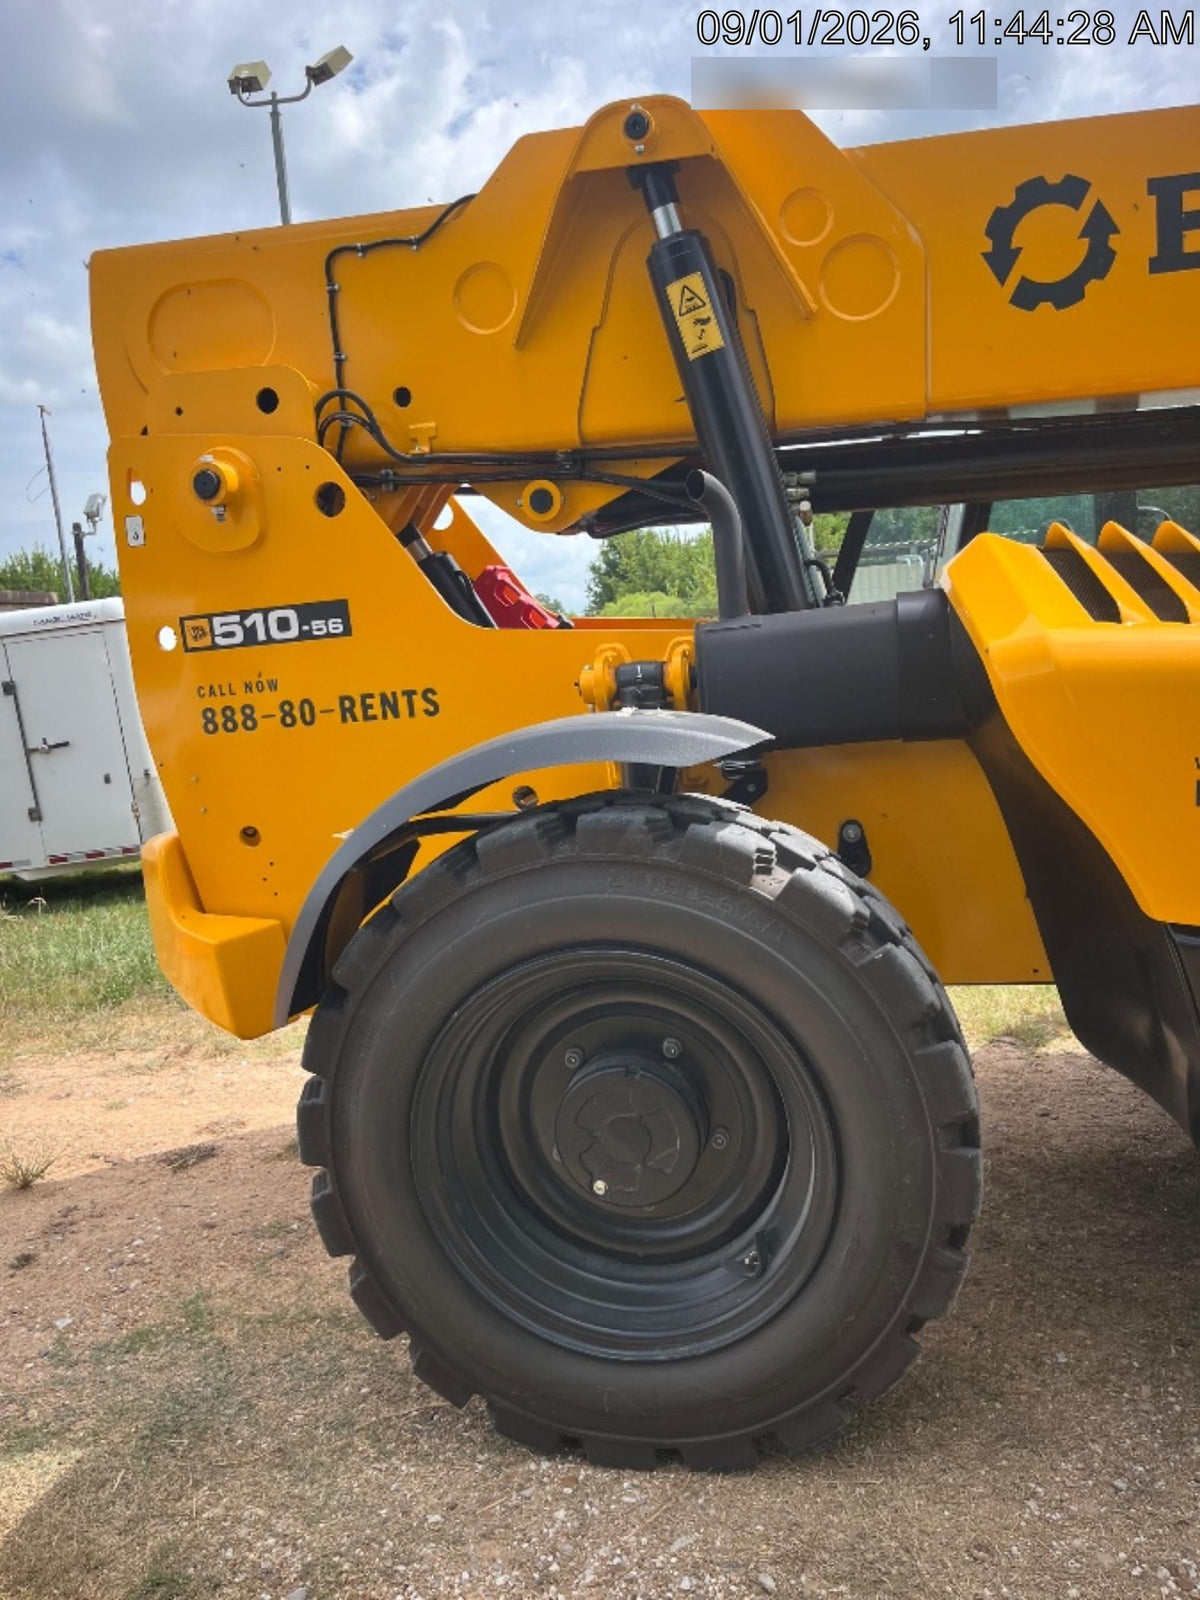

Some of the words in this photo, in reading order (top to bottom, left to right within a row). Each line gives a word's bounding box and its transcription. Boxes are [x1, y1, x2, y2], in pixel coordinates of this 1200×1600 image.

[211, 608, 344, 647] 510-56
[196, 683, 236, 698] CALL
[244, 678, 279, 694] NOW
[201, 687, 440, 735] 888-80-RENTS
